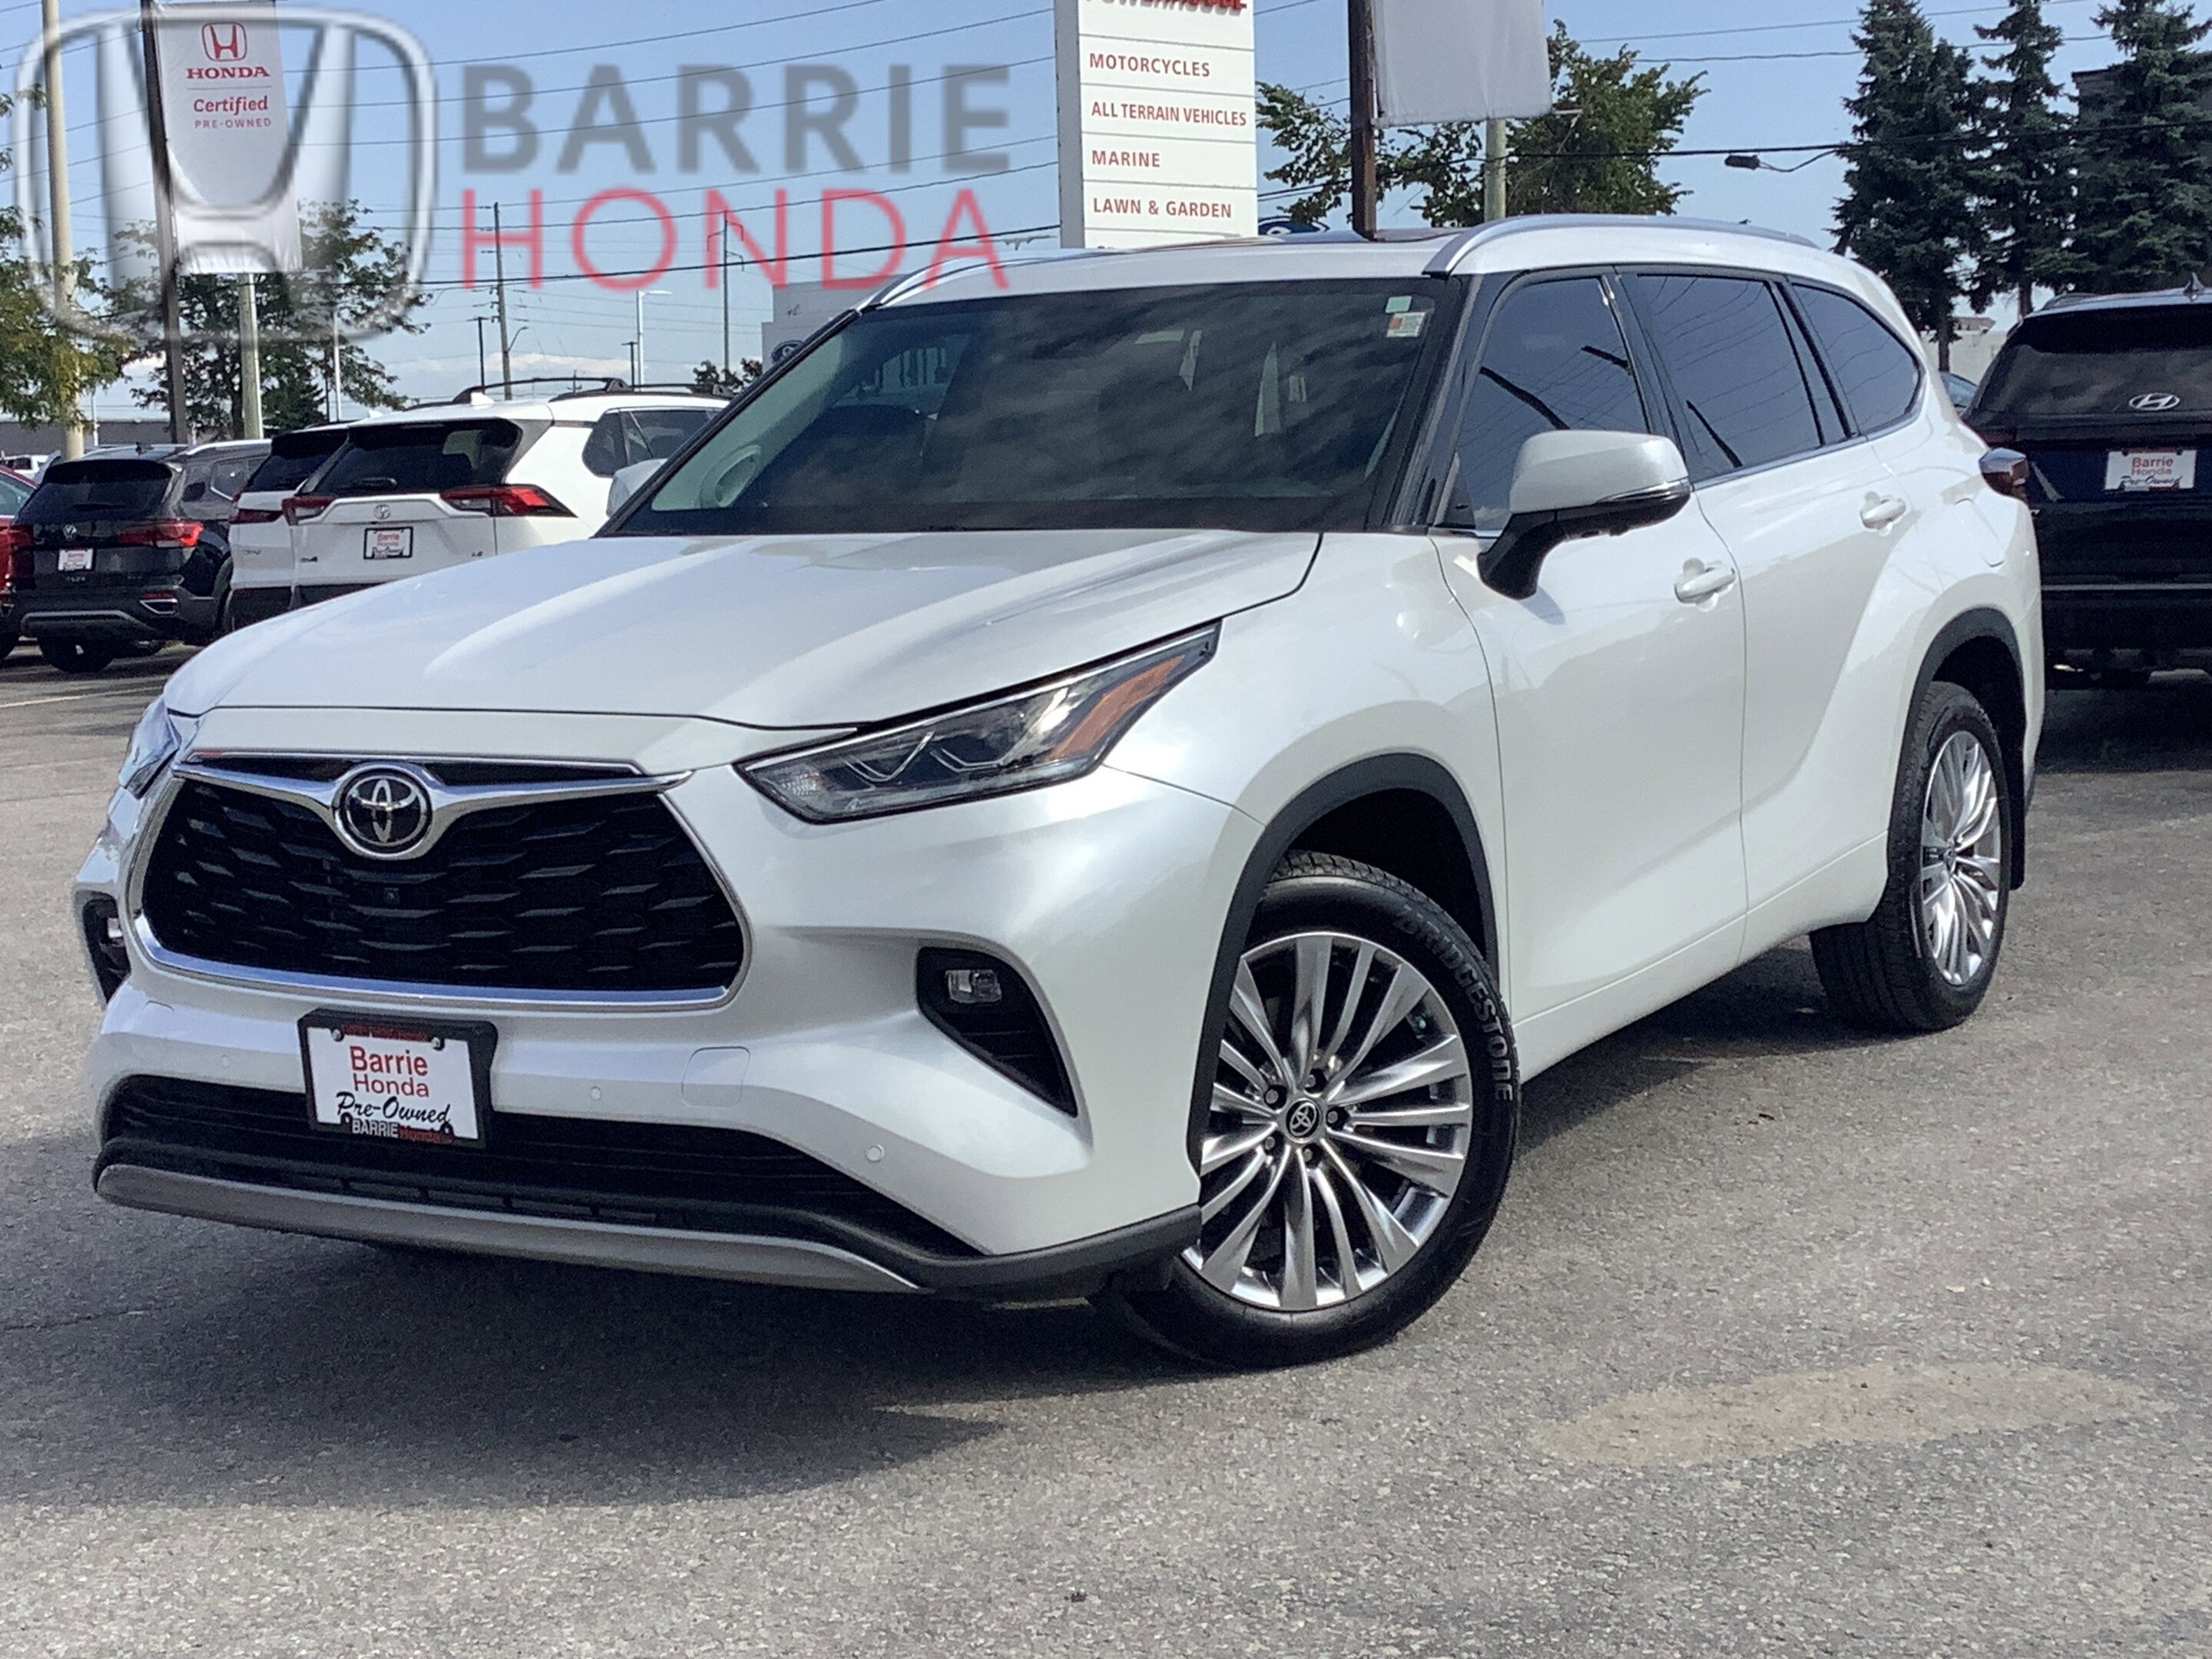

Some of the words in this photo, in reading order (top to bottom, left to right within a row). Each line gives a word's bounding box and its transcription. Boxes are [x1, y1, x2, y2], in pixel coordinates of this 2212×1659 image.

[187, 67, 270, 79] HONDA
[1089, 53, 1210, 78] MOTORCYCLES
[194, 95, 269, 115] Certified
[1091, 101, 1118, 118] ALL
[1121, 103, 1180, 122] TERRAIN
[1183, 108, 1247, 127] VEHICLES
[194, 118, 271, 129] PRE-OWNED
[1091, 150, 1161, 168] MARINE
[1093, 197, 1141, 215] LAWN
[1148, 200, 1159, 216] &
[1166, 200, 1232, 219] GARDEN
[2132, 456, 2174, 468] Barrie
[1394, 904, 1514, 1102] BRIDGESTONE
[349, 1045, 429, 1076] Barrie
[353, 1073, 429, 1098] Honda
[335, 1091, 451, 1124] Pre-Owned
[352, 1118, 399, 1138] BARRIE
